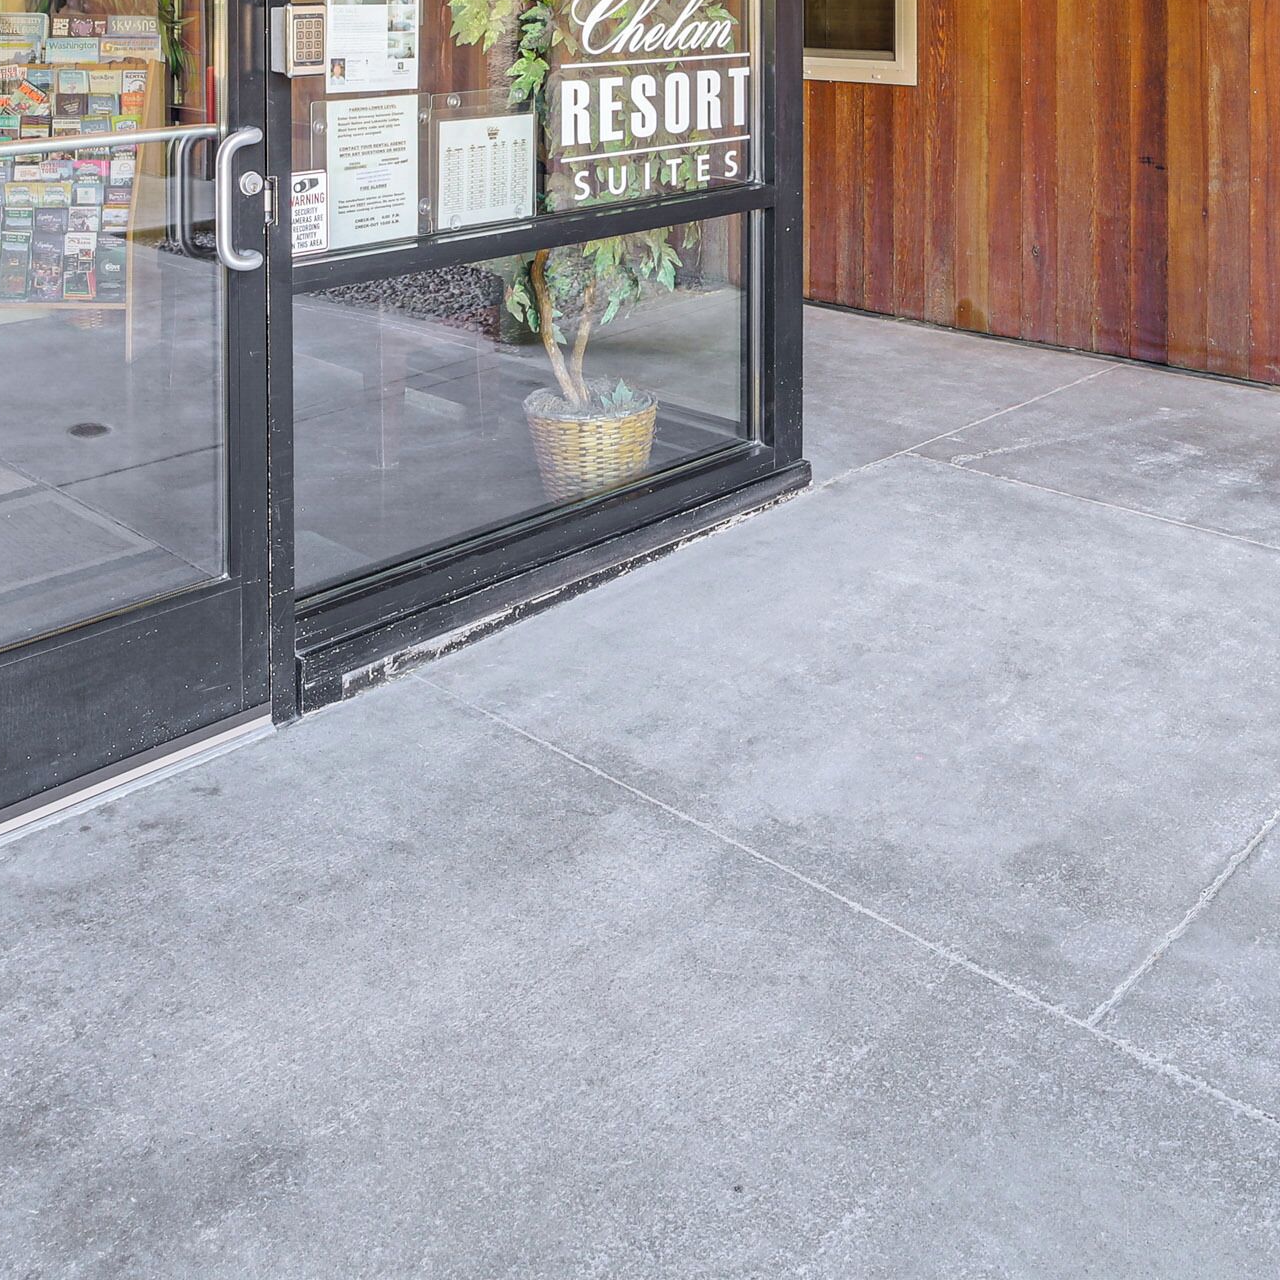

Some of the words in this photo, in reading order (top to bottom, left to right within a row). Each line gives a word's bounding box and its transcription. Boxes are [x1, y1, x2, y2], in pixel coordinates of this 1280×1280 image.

[49, 42, 97, 50] Washington
[560, 66, 751, 147] RESORT
[574, 150, 738, 201] SUITES
[294, 207, 318, 216] SECURITY
[292, 216, 312, 224] AMERAS
[293, 223, 320, 232] RECORDING
